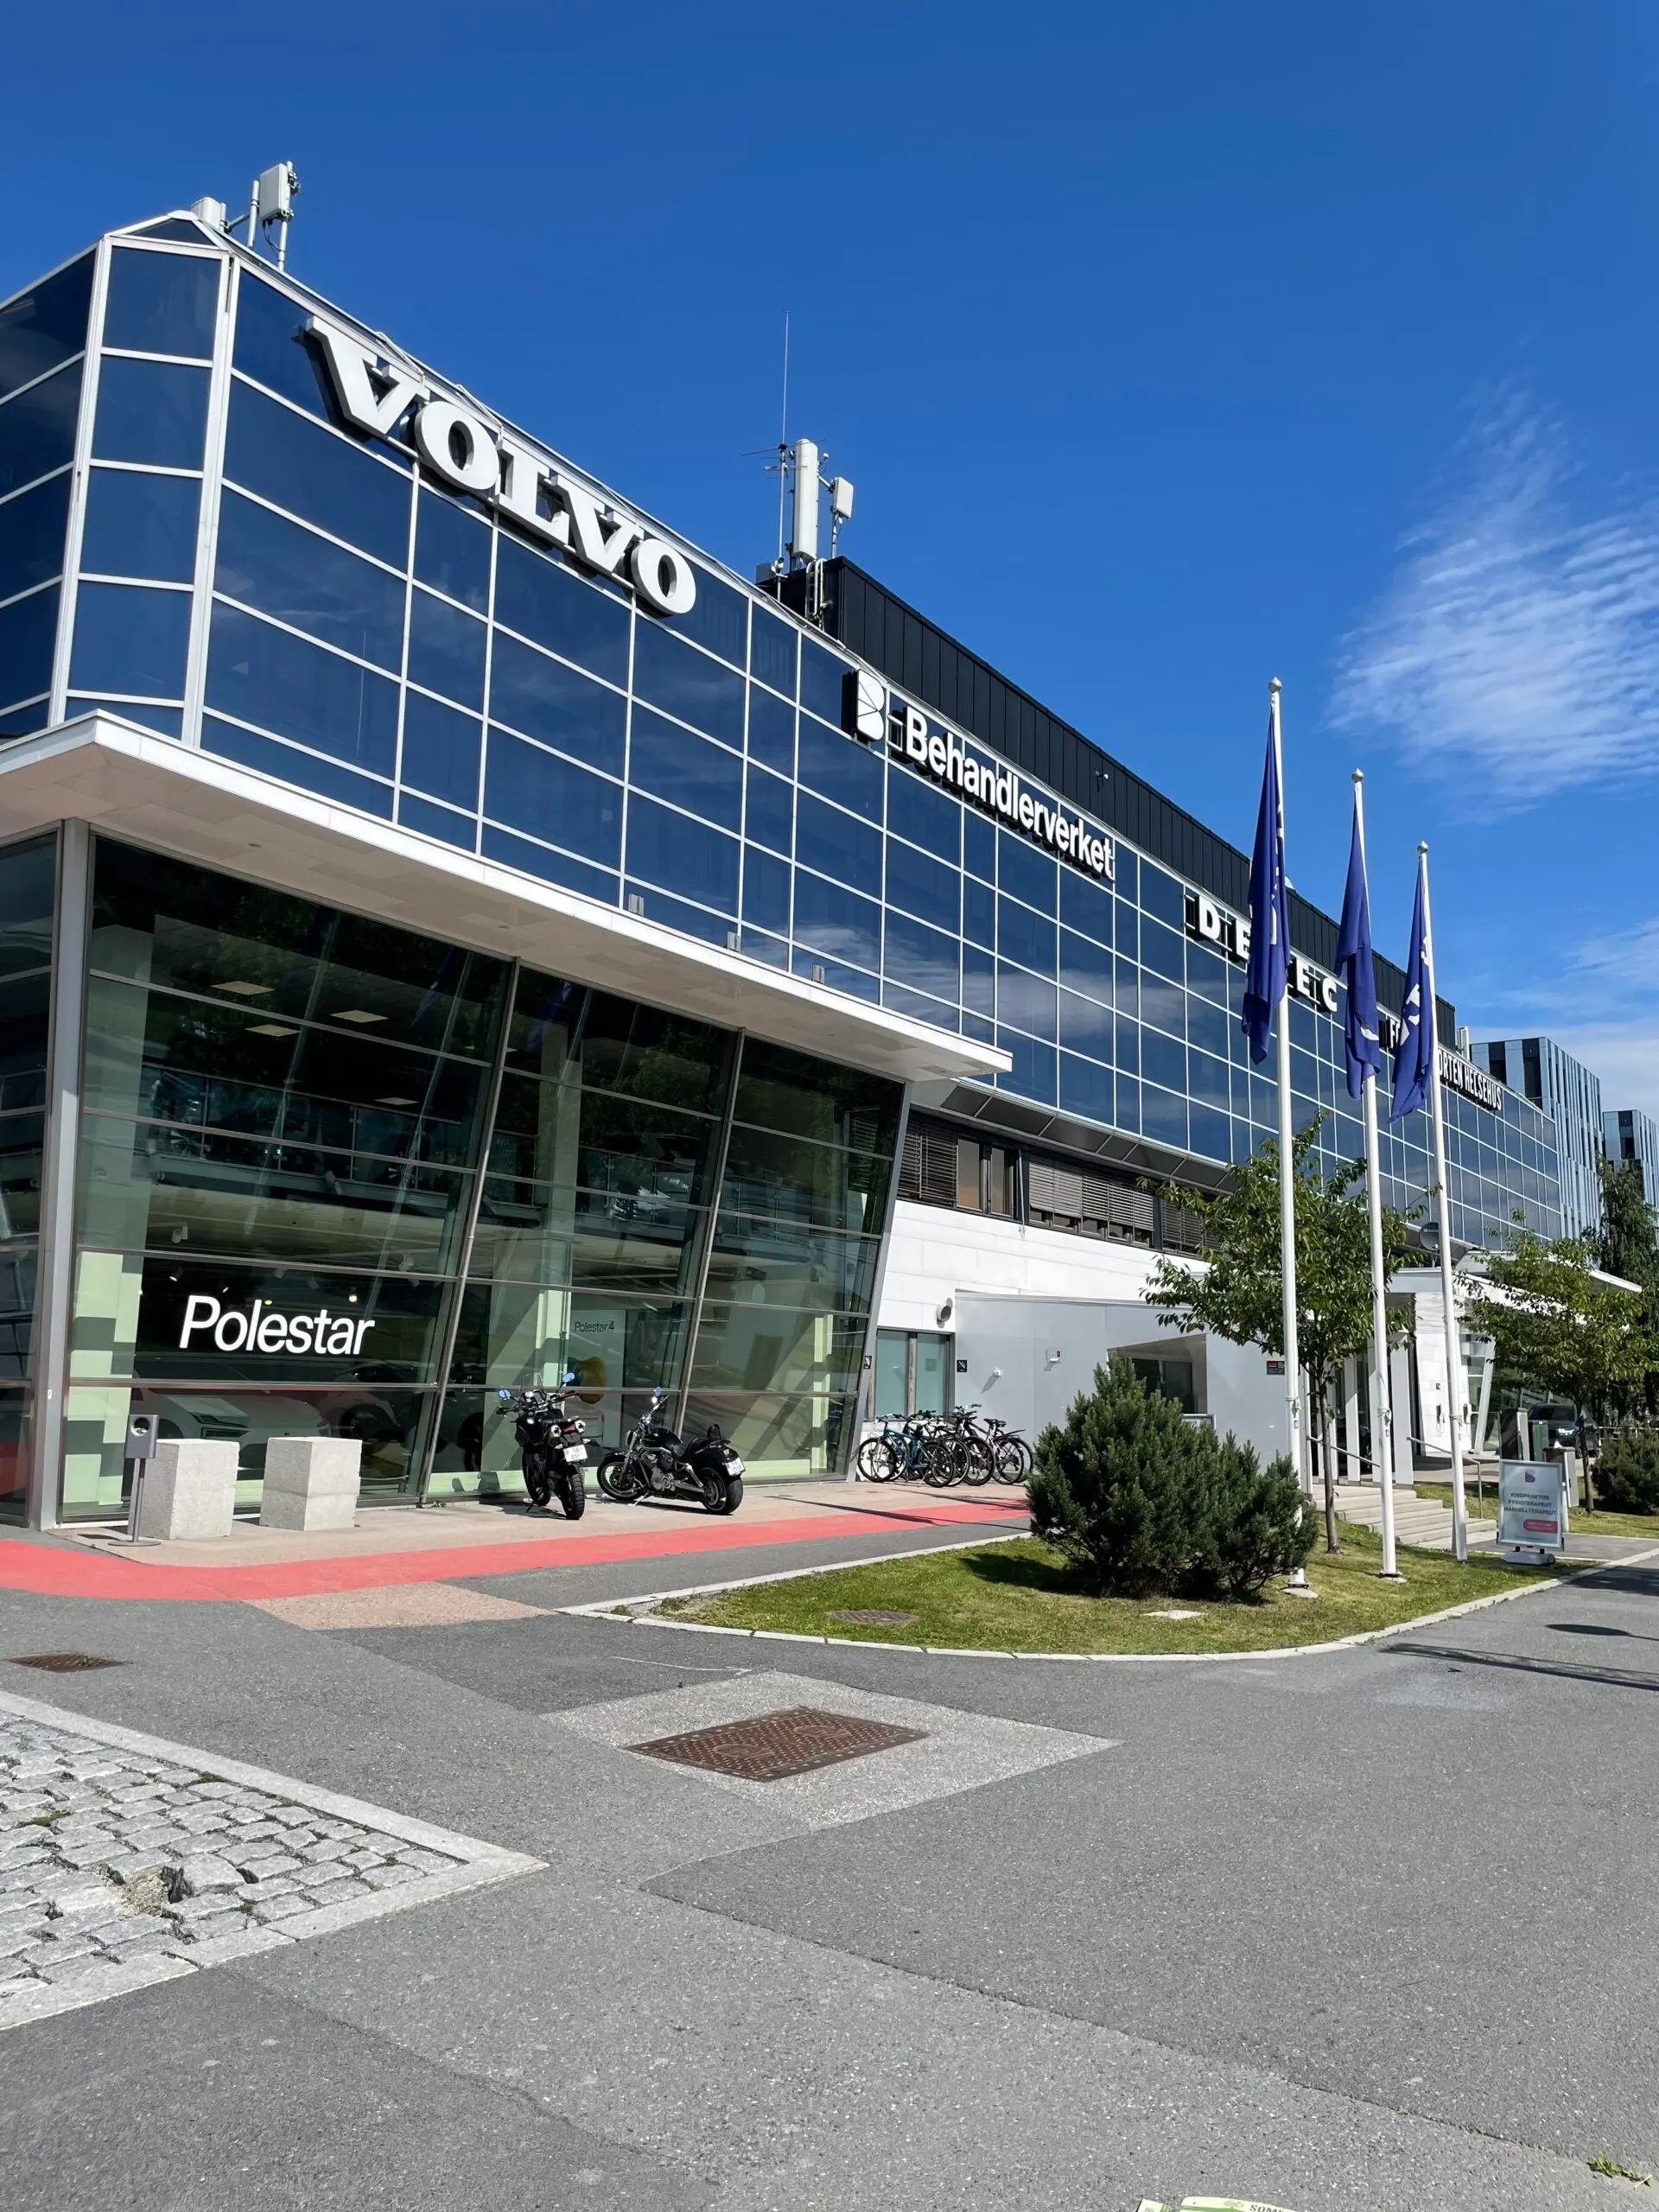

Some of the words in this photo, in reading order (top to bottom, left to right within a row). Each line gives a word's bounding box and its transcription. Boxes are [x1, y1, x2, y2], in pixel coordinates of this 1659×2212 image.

[306, 315, 696, 614] VOLVO
[906, 705, 1115, 879] Behandlerverket
[1198, 894, 1338, 1012] DEEC
[1464, 1065, 1502, 1111] HELSEHUS
[179, 1294, 376, 1355] Polestar
[575, 1321, 607, 1332] Polestar
[608, 1320, 614, 1331] 4
